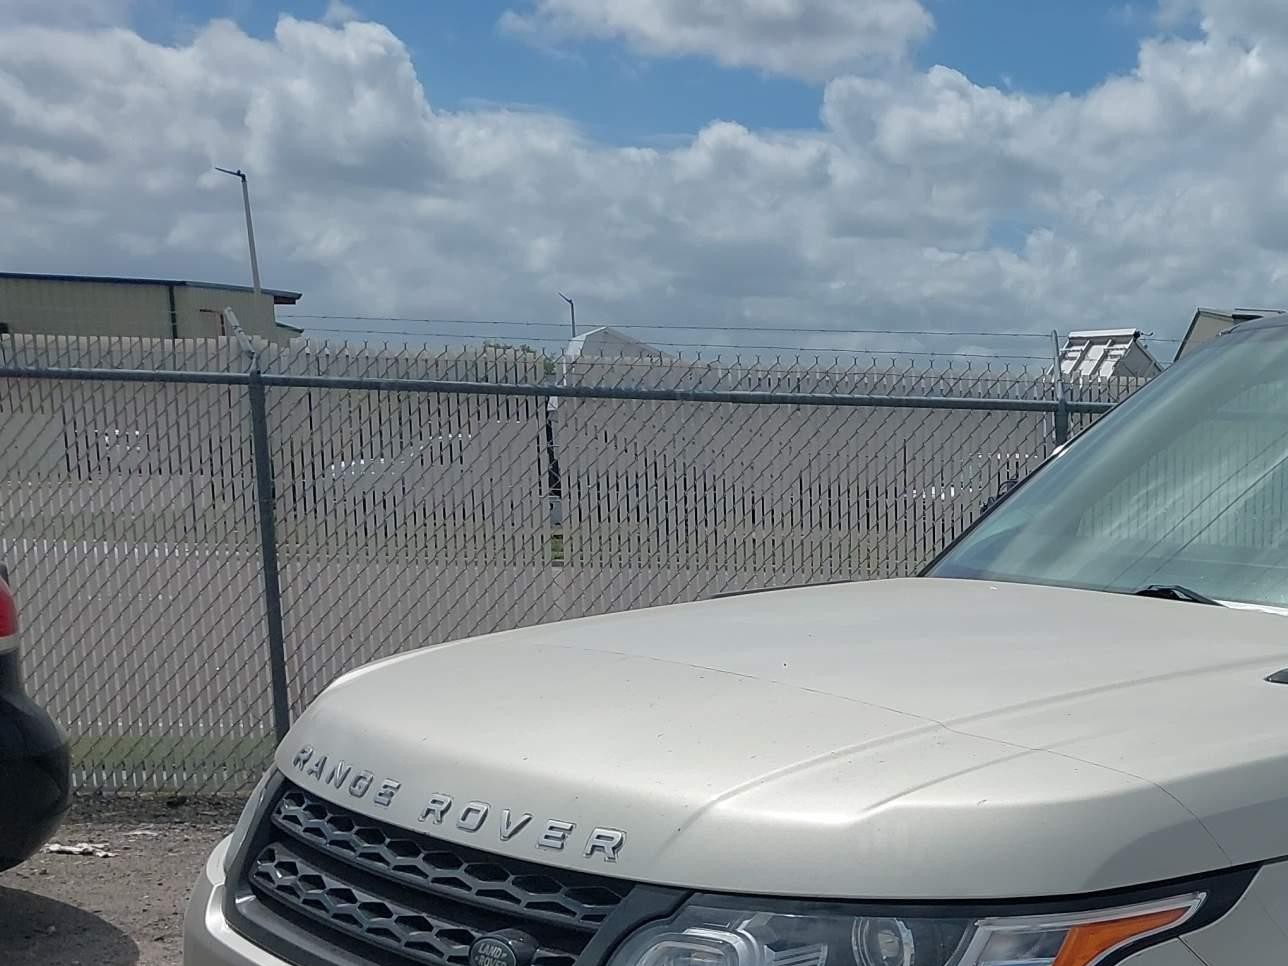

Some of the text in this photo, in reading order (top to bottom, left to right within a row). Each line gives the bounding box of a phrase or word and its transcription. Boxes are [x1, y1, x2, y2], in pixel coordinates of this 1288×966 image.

[292, 744, 628, 864] RANGE ROVER
[478, 943, 502, 958] LAND
